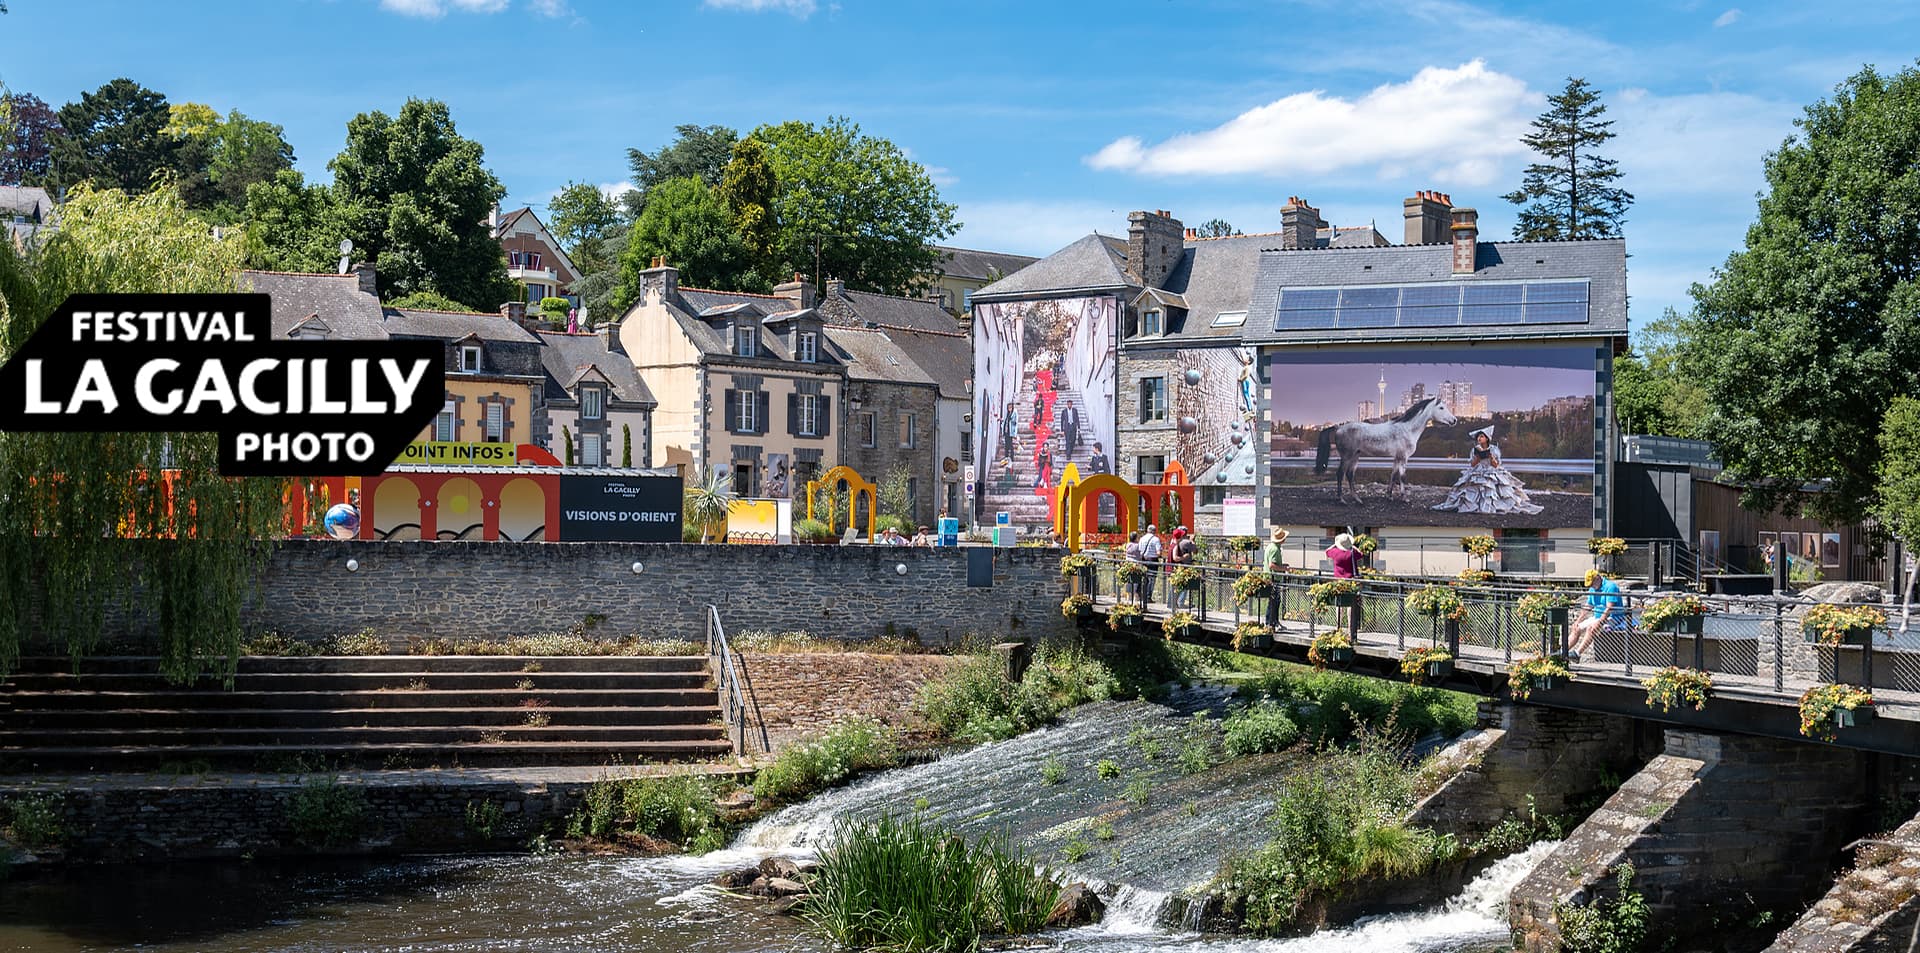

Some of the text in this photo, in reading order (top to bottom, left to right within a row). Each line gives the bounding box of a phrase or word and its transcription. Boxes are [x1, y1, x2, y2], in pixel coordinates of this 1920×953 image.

[405, 445, 504, 459] OINT INFOS
[603, 486, 613, 494] LA
[565, 510, 677, 523] VISIONS D’ORIENT
